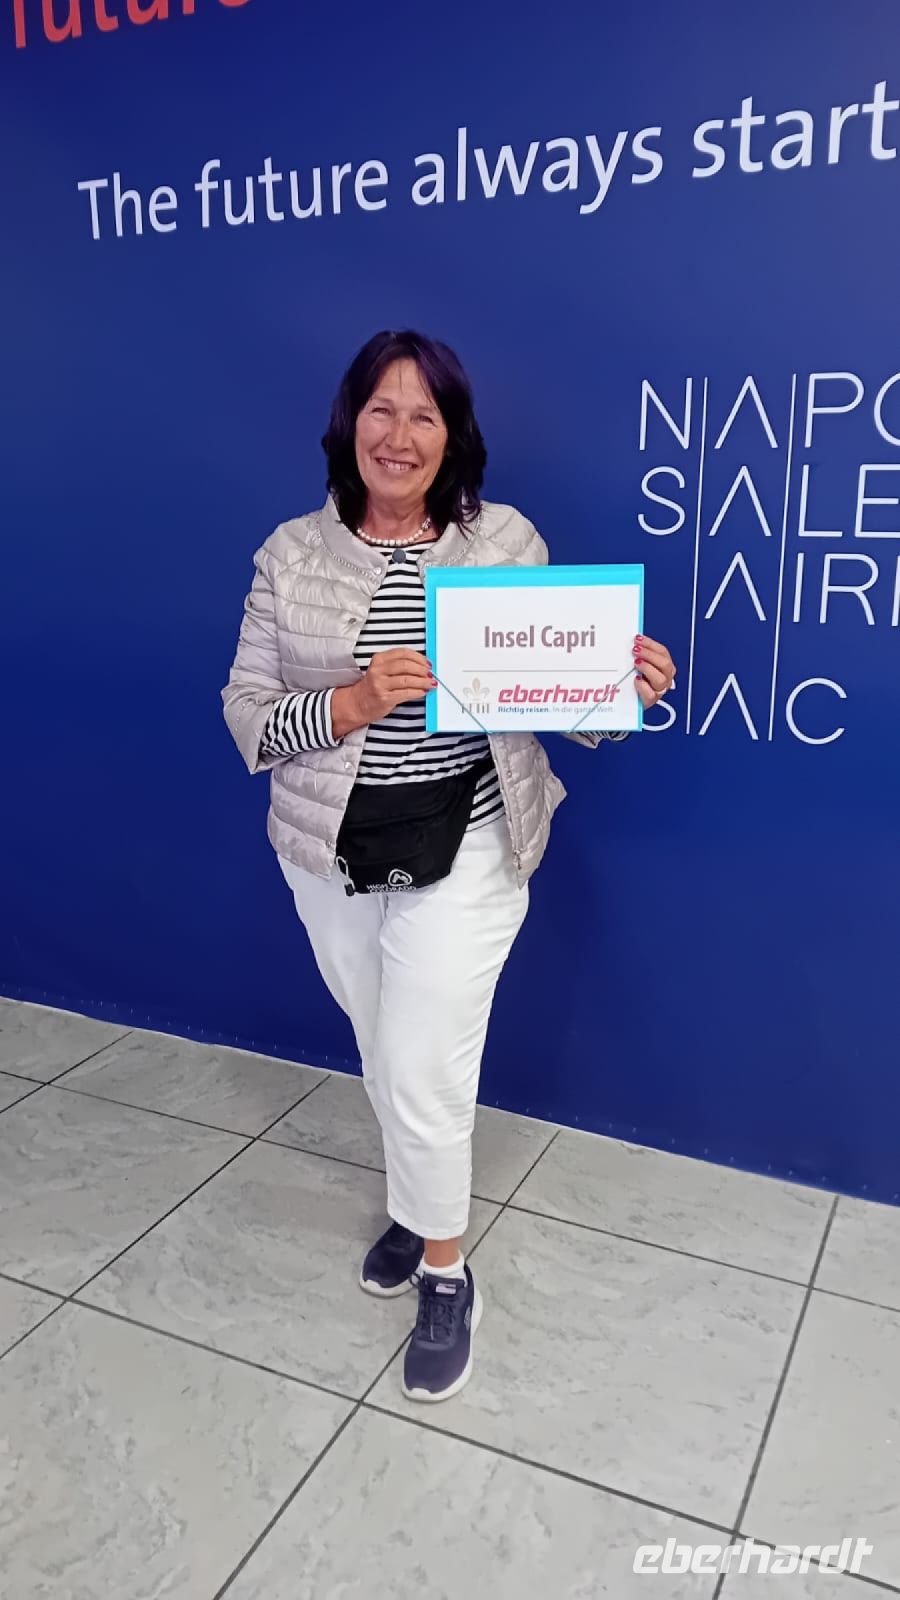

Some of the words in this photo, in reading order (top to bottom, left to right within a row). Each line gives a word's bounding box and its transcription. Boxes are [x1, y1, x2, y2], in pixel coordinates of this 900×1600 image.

[78, 173, 178, 240] The
[195, 157, 389, 228] future
[411, 126, 663, 215] always
[692, 80, 900, 178] start
[638, 463, 900, 538] SALE
[704, 551, 900, 627] AIR
[484, 625, 535, 648] Insel
[541, 624, 595, 653] Capri
[498, 684, 620, 703] eberhardt
[498, 706, 525, 715] Richtig
